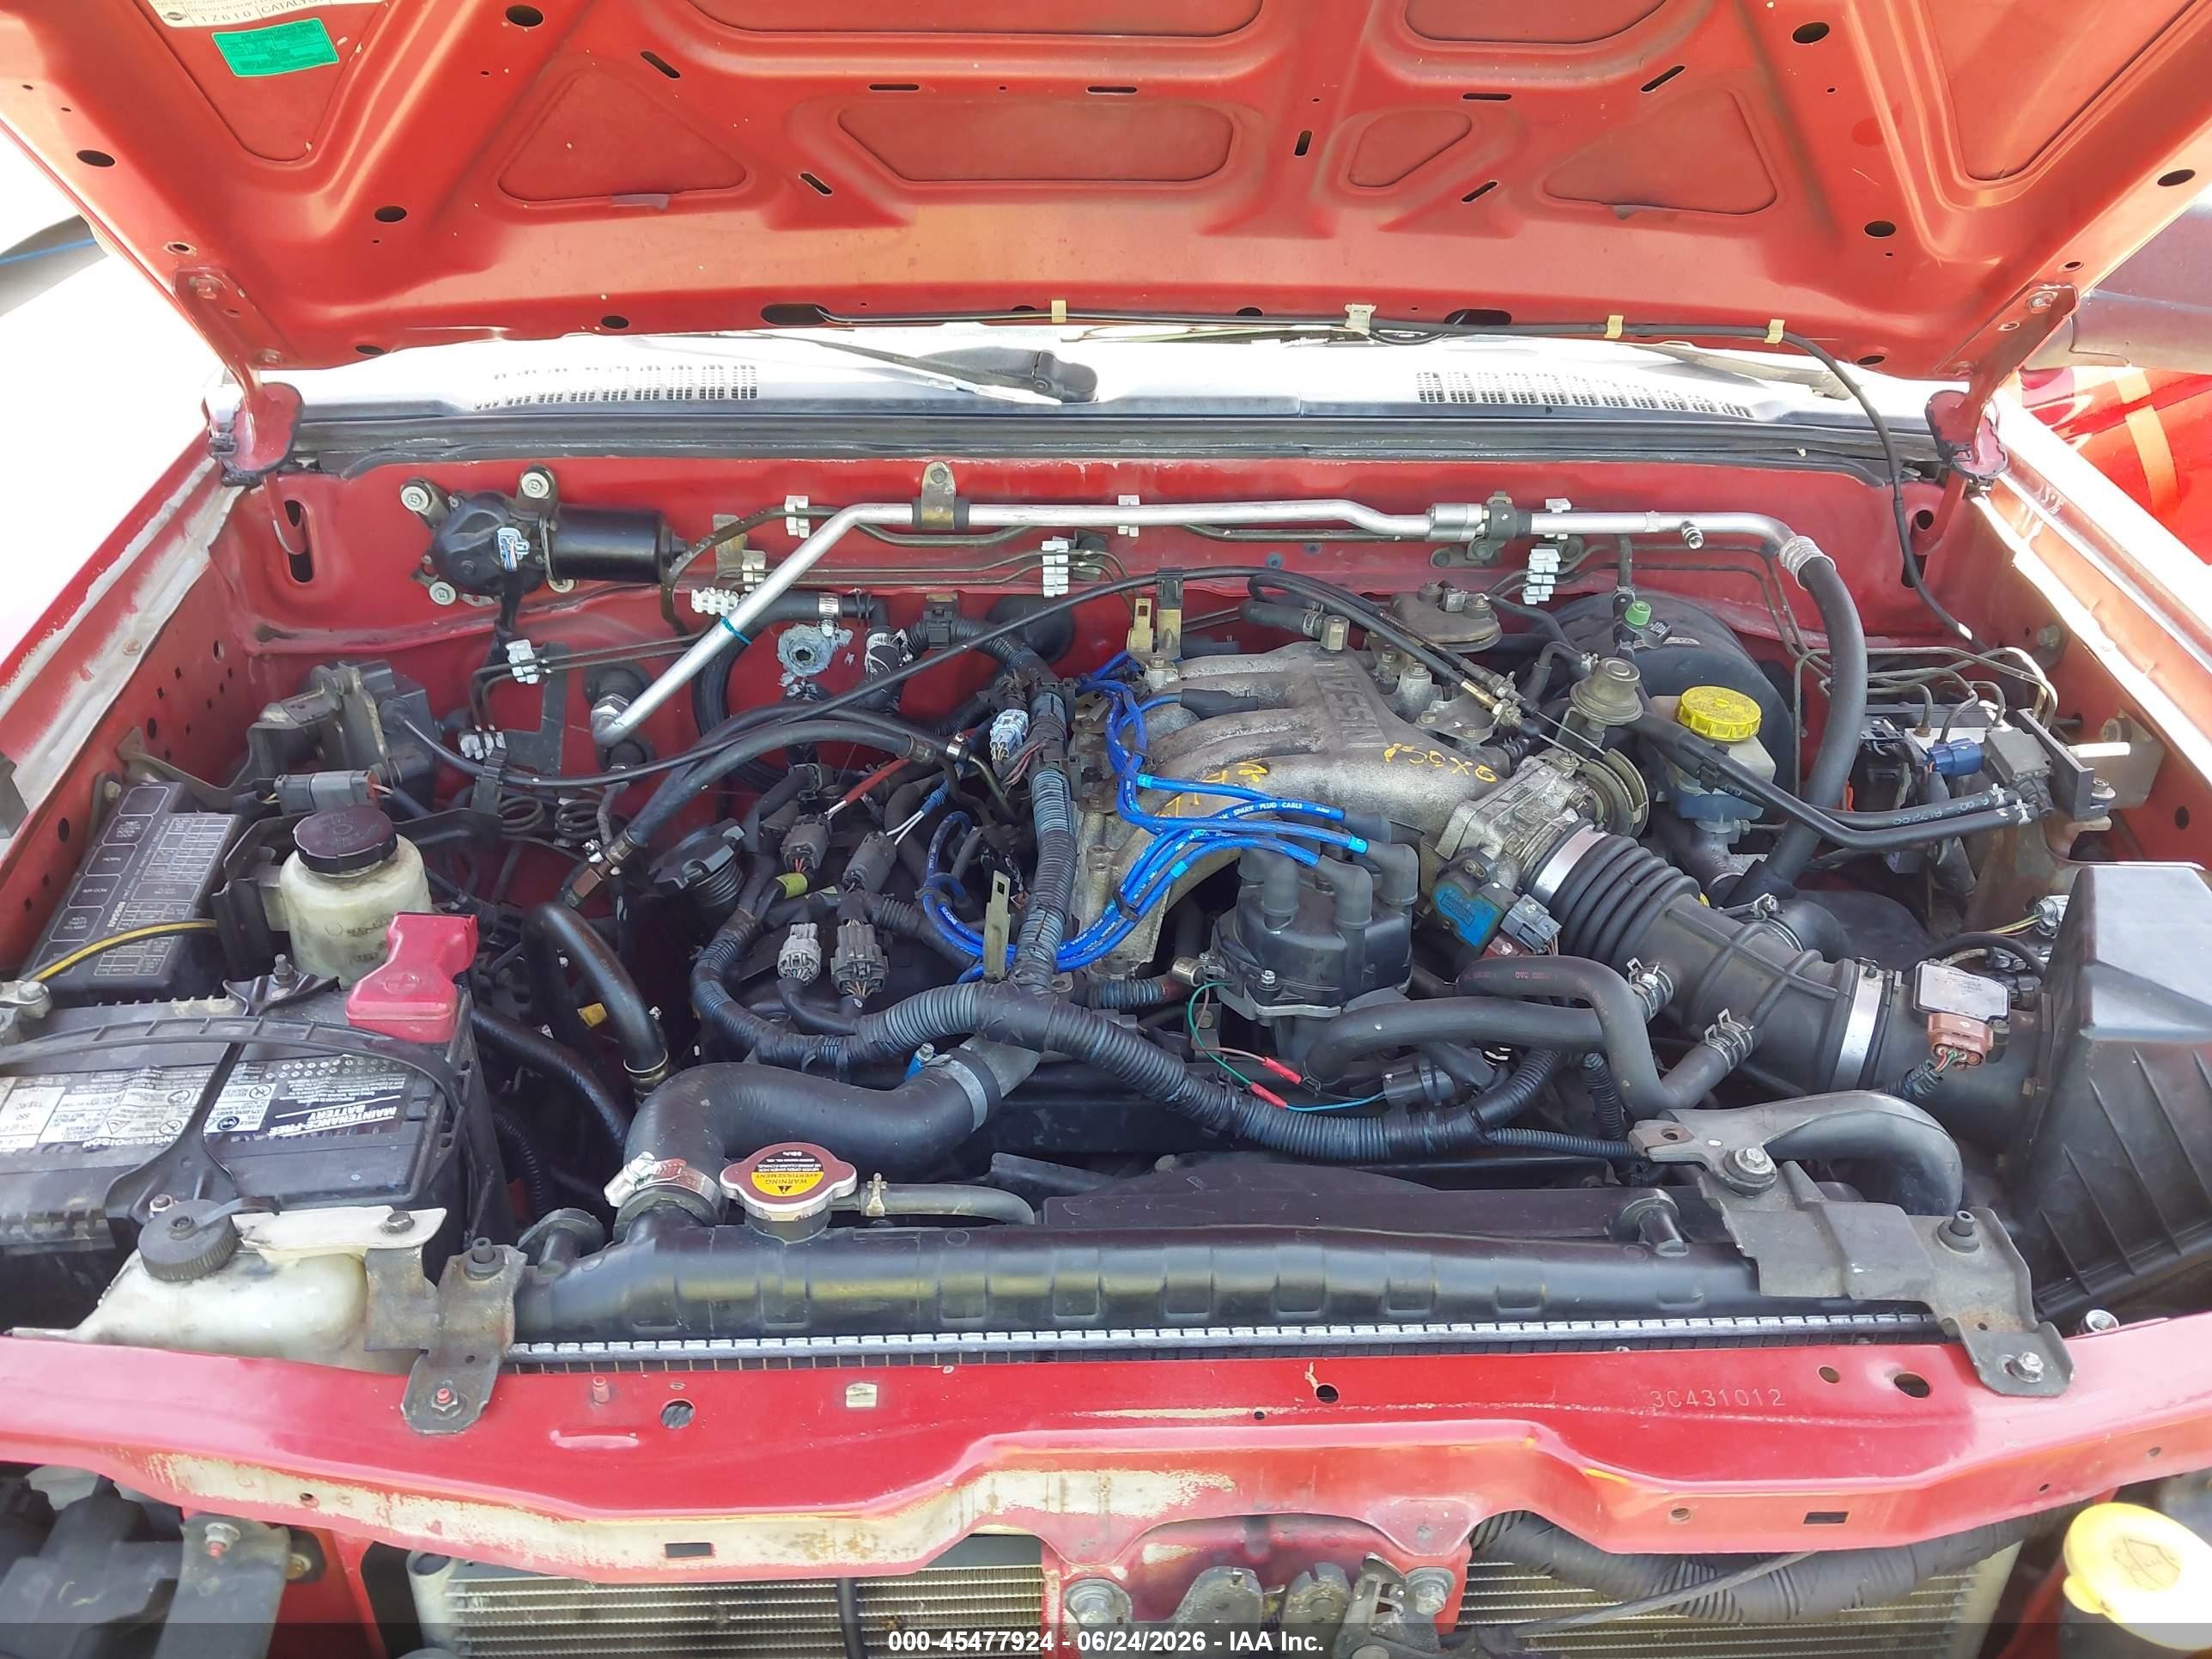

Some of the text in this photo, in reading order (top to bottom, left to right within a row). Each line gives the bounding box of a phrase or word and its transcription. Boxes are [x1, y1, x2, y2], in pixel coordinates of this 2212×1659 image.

[1281, 801, 1304, 810] CABLE
[268, 1107, 398, 1136] MAINTENANCE-FREE
[307, 1104, 367, 1122] BATTERY
[1649, 1388, 1787, 1408] 3C431012
